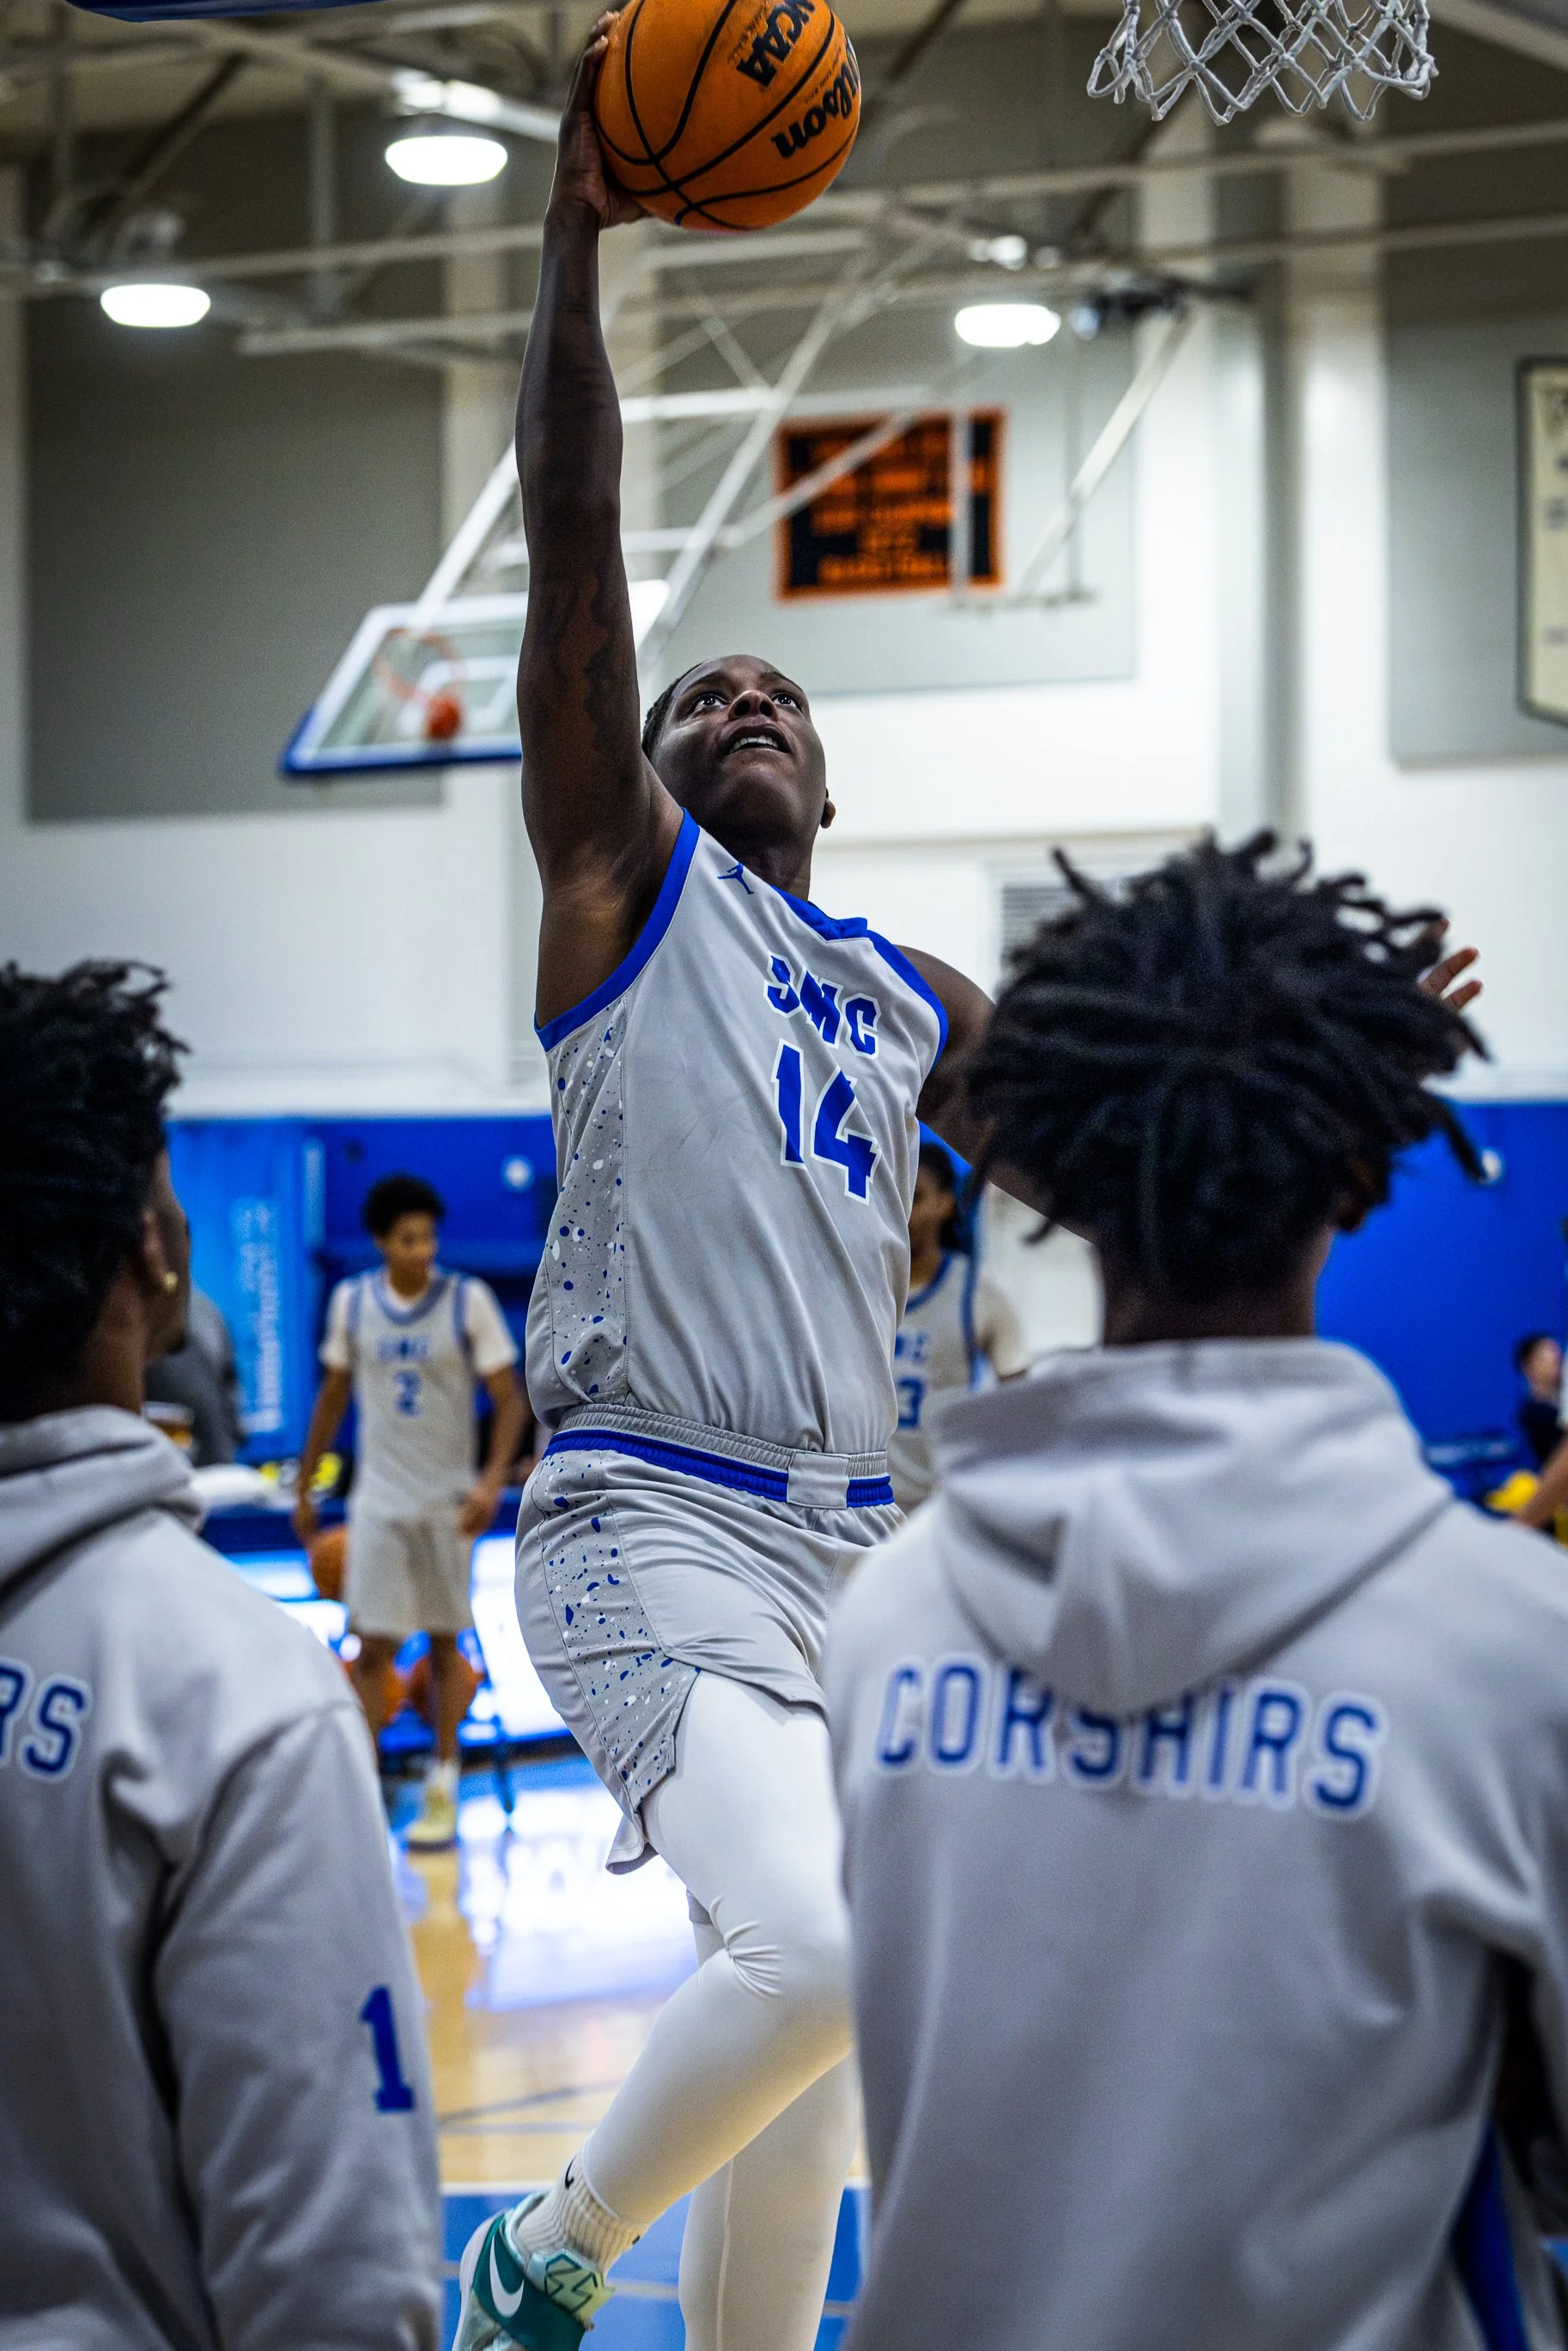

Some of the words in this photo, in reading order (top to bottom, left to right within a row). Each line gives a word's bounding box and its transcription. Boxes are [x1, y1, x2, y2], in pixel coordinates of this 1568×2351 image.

[737, 0, 815, 87] NCAA
[766, 954, 880, 1060] SMC
[771, 1039, 880, 1205] 14
[871, 1652, 1386, 1819] CORSAIRS
[360, 1984, 415, 2112] 1
